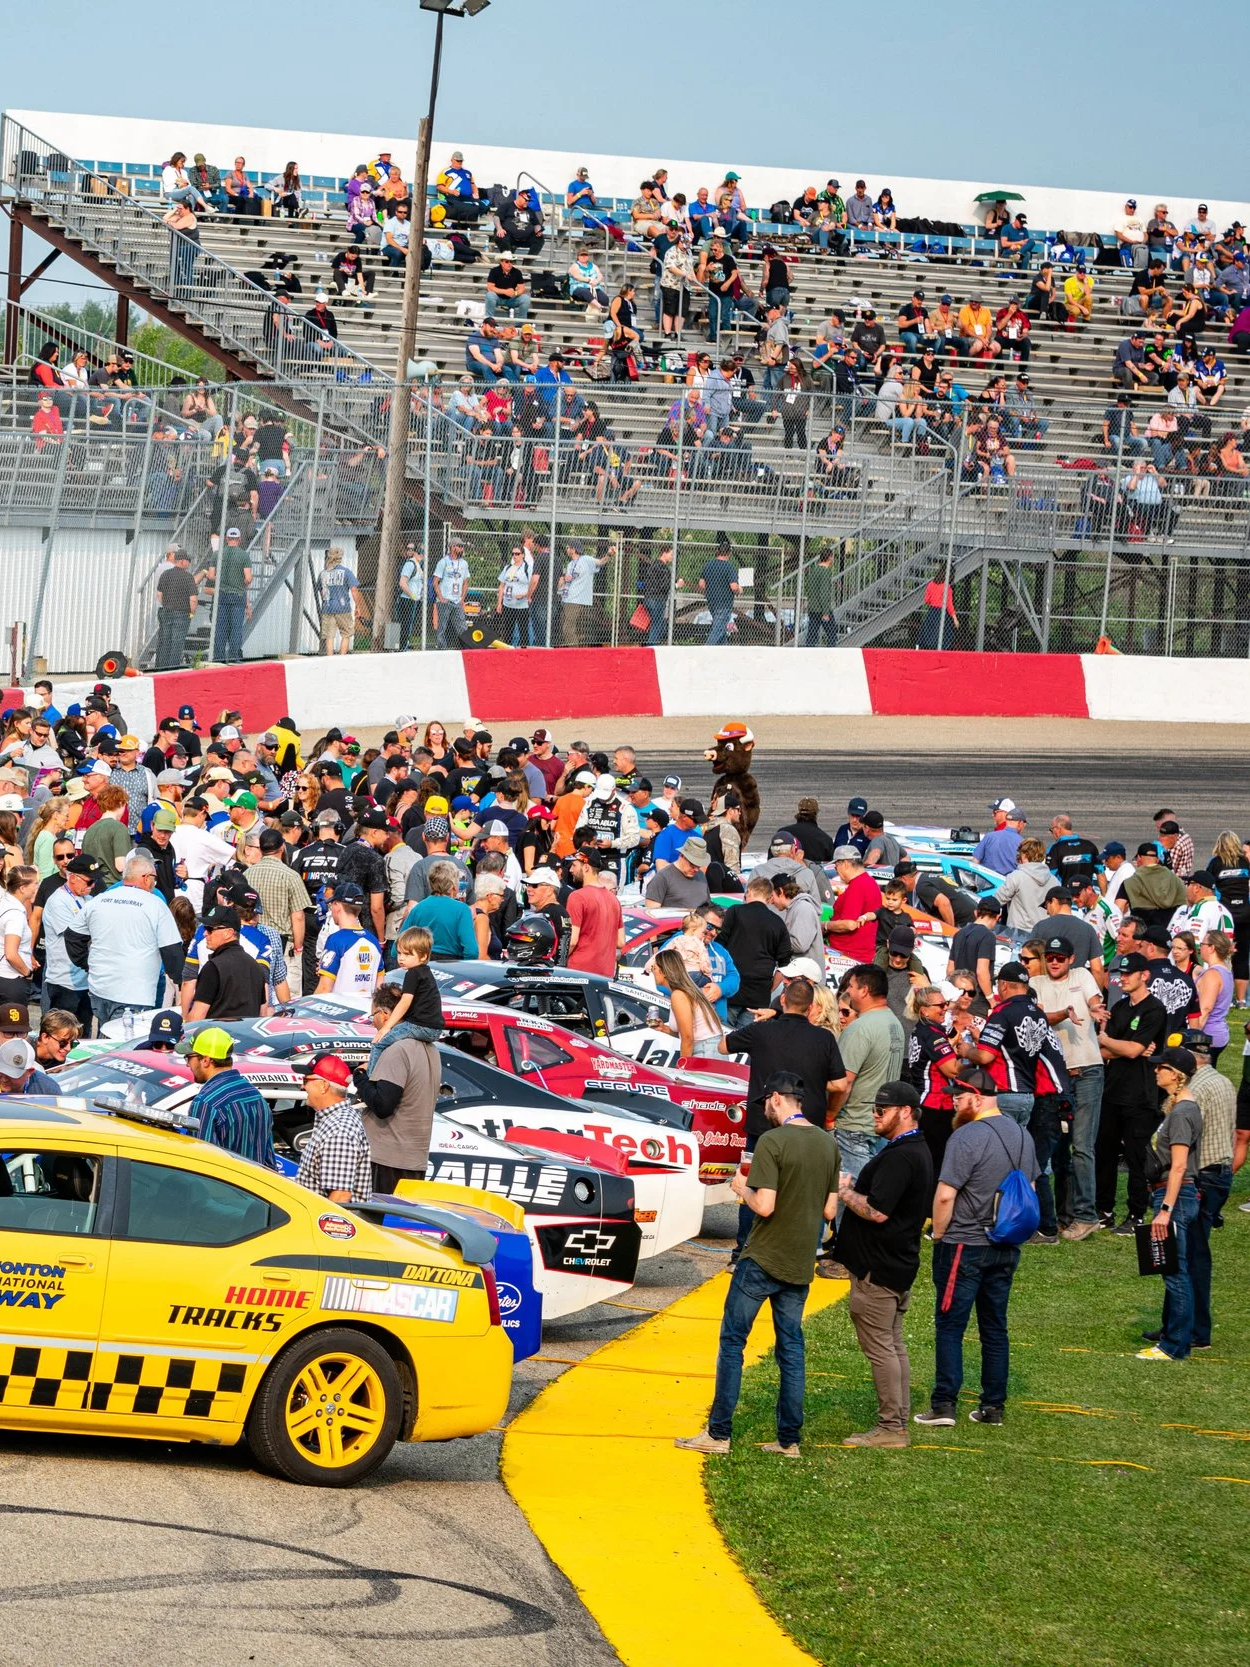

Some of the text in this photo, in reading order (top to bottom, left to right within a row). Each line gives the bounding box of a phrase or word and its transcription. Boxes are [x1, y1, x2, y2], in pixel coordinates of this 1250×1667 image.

[115, 899, 143, 908] MCMURRAY
[358, 953, 372, 965] NAPA
[624, 986, 657, 1002] SANGSIN
[451, 1011, 479, 1020] Jamie
[591, 1057, 637, 1074] YARDMASTER
[682, 1100, 727, 1112] shade
[426, 1156, 568, 1206] AILLE
[563, 1257, 613, 1267] CHEVROLET
[402, 1264, 476, 1287] DAYTONA
[224, 1286, 314, 1310] HOME
[361, 1285, 456, 1321] NASCAR
[169, 1304, 285, 1333] TRACKS
